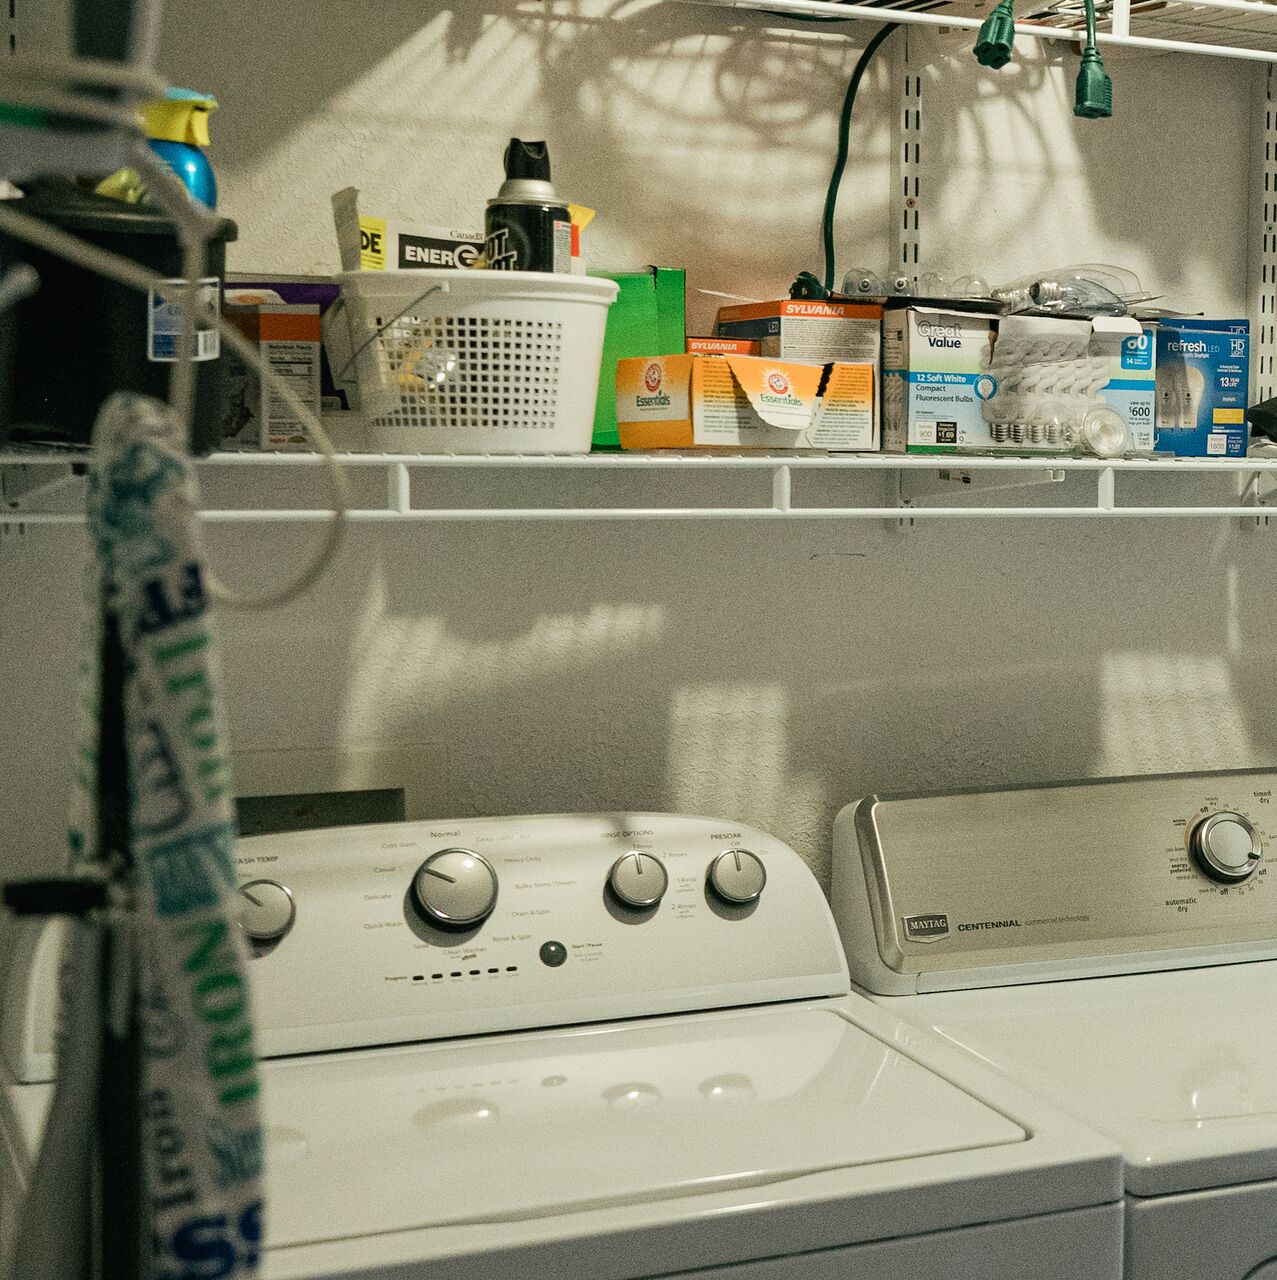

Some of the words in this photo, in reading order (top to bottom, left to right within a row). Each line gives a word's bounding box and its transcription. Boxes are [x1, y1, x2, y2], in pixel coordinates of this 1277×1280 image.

[785, 304, 845, 316] SYLVANIA
[917, 321, 962, 338] Great
[690, 342, 738, 352] SYLVANIA
[928, 337, 962, 349] Value
[1167, 340, 1207, 352] refresh
[1208, 345, 1220, 353] LED
[1231, 341, 1245, 351] HD
[917, 373, 925, 382] 12
[927, 374, 943, 383] Soft
[944, 374, 967, 384] White
[1220, 377, 1229, 388] 13
[915, 385, 946, 393] Compact
[636, 391, 671, 407] Essentials
[760, 393, 803, 407] Essentials
[1128, 406, 1151, 417] $600
[1253, 790, 1272, 798] timed
[1259, 797, 1270, 805] dry
[1200, 806, 1209, 814] off
[430, 830, 461, 839] Normal
[622, 830, 655, 838] OPTIONS
[1170, 867, 1192, 875] preferred
[1258, 868, 1267, 876] off
[1165, 897, 1198, 906] automatic
[1177, 905, 1188, 913] dry
[910, 919, 947, 930] MAYTAG
[957, 919, 1022, 932] CENTENNIAL
